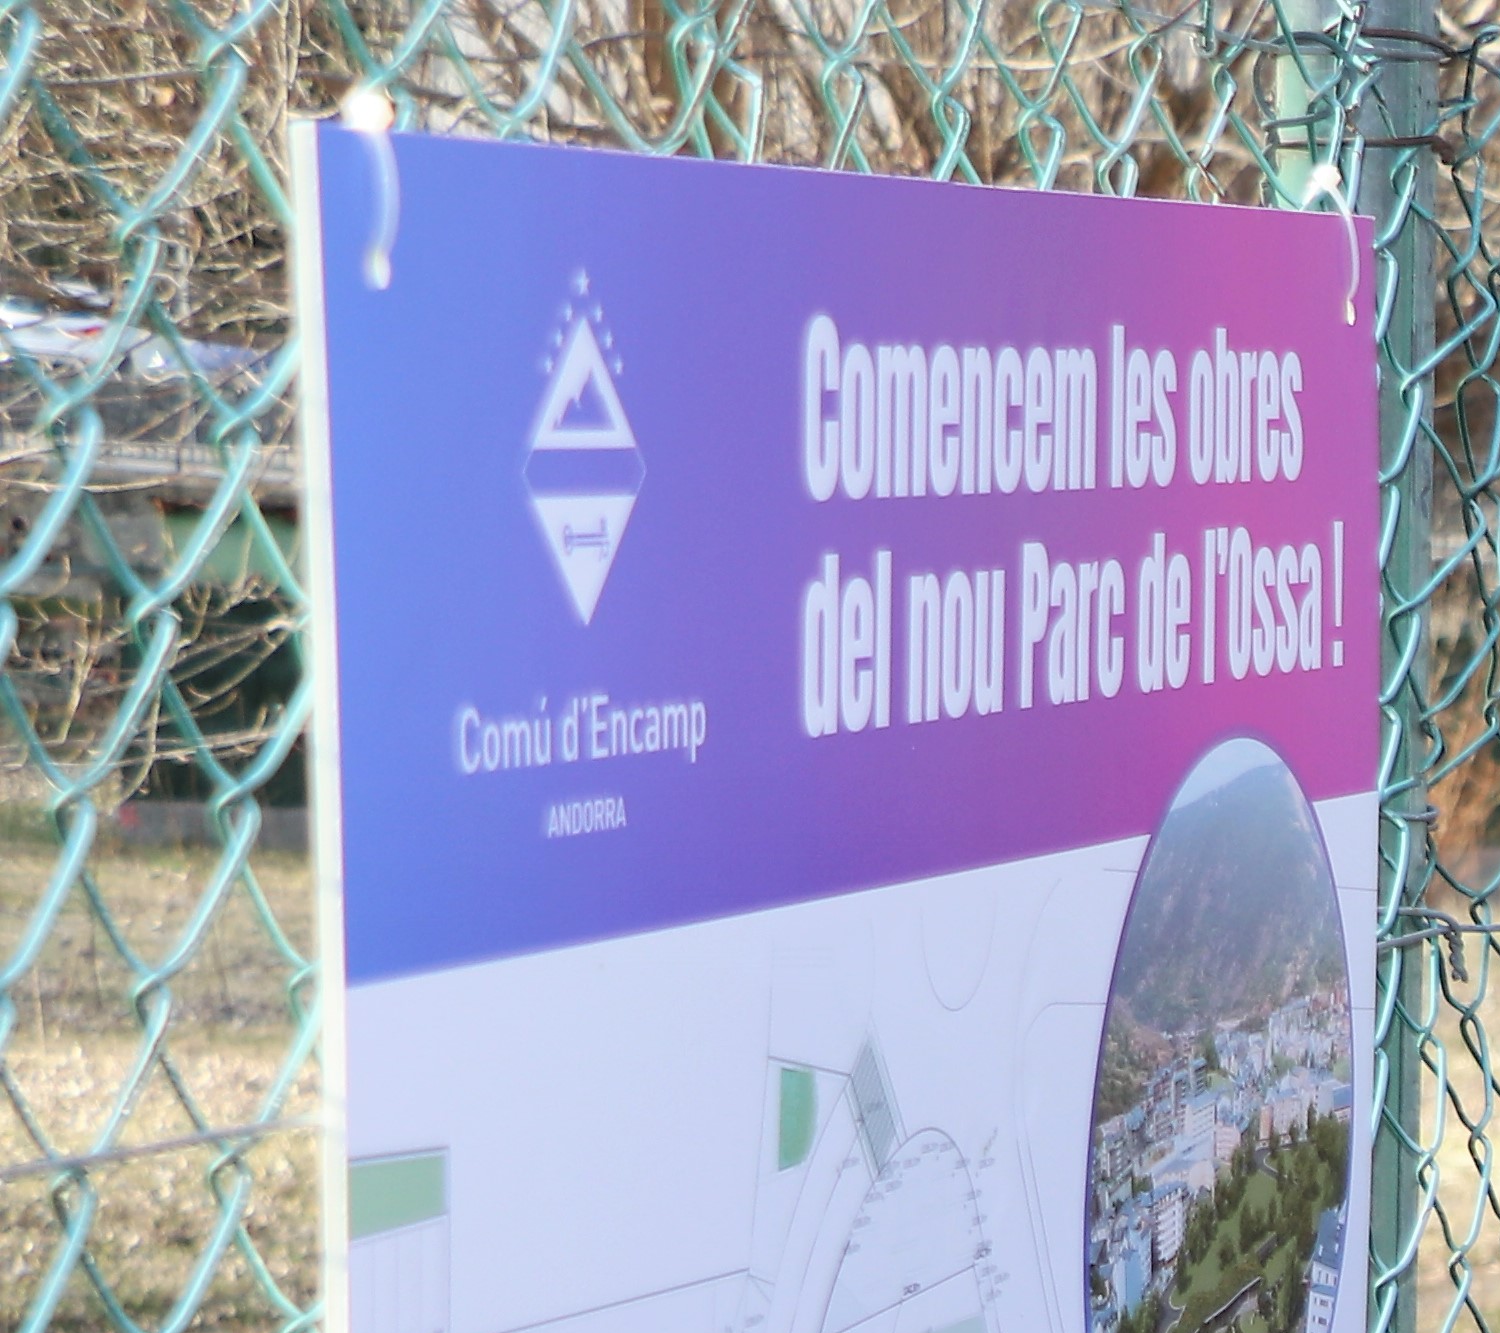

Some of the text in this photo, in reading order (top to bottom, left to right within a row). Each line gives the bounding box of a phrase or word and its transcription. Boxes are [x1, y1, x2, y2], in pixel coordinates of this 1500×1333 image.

[806, 315, 1304, 502] Comencem les obres
[805, 550, 892, 738] del
[908, 569, 1006, 725] nou
[1020, 542, 1125, 710] Parc
[1138, 532, 1192, 694] de
[1203, 526, 1322, 684] l'Ossa
[460, 694, 708, 775] Comú d'Encamp
[547, 797, 627, 838] ANDORRA
